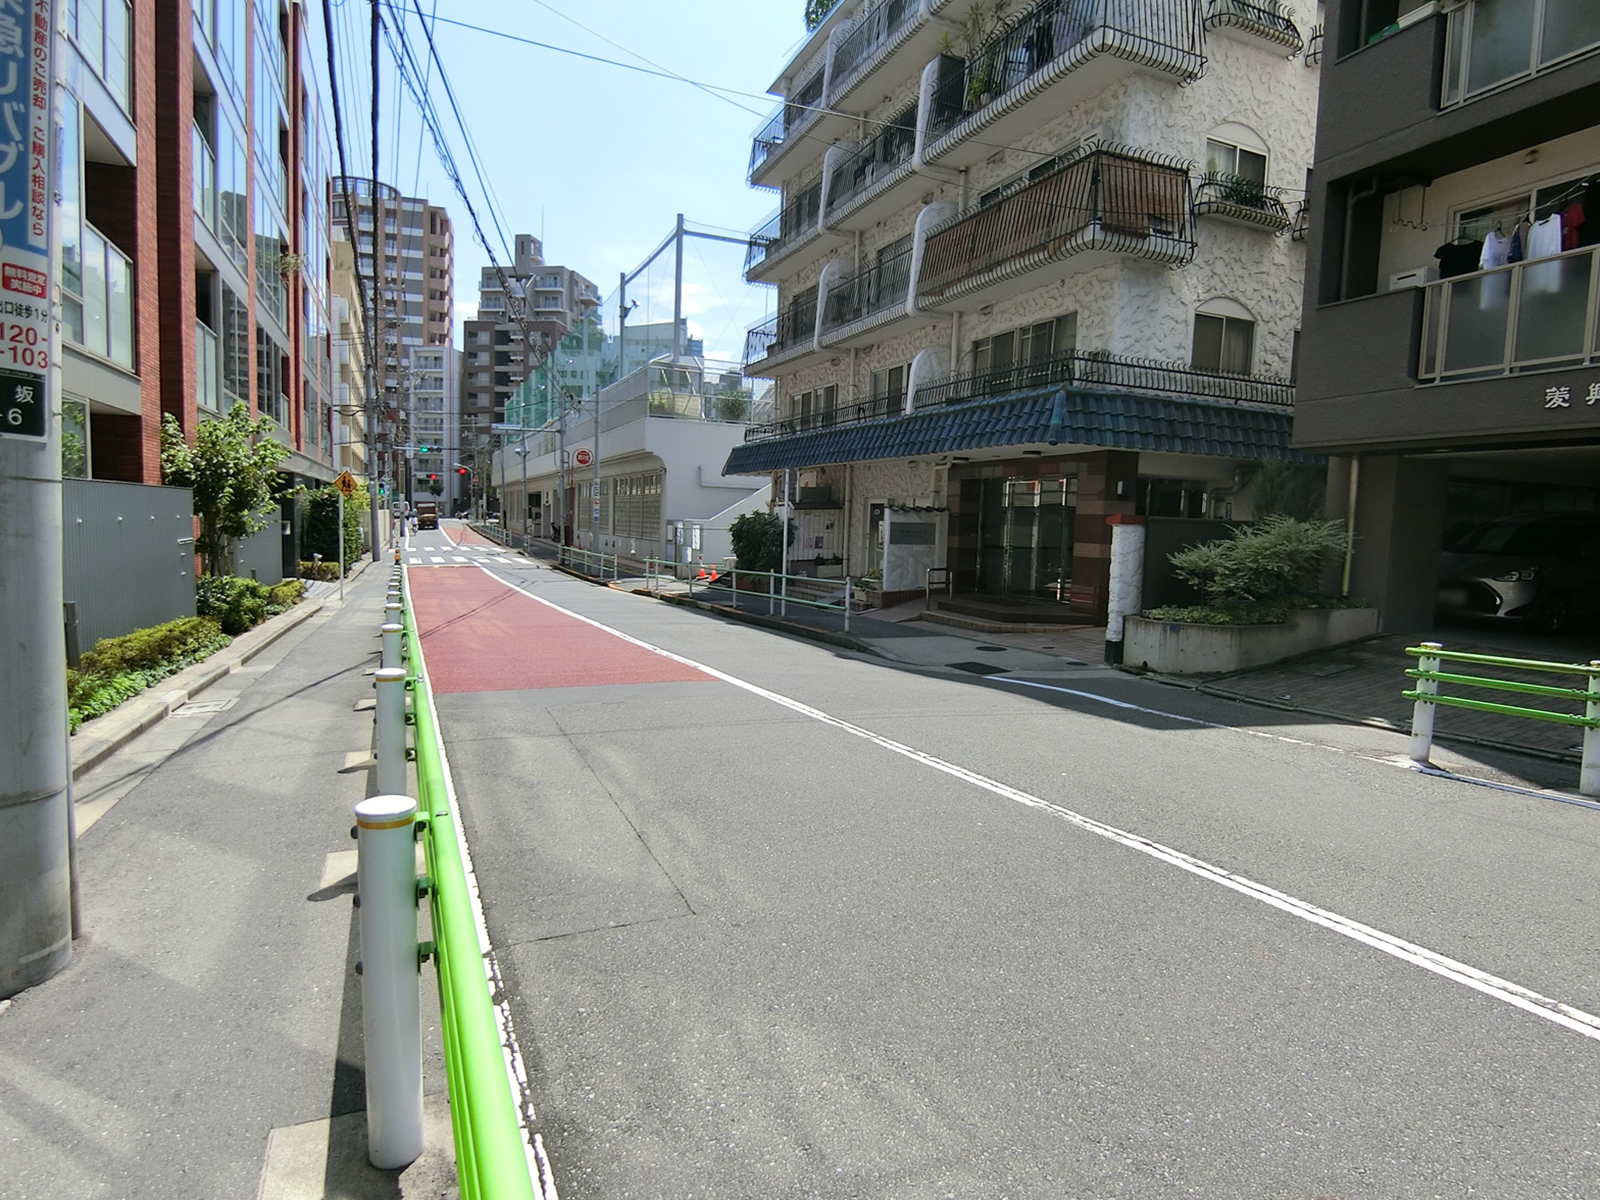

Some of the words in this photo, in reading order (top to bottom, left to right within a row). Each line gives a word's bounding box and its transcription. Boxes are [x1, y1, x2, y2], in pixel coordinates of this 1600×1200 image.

[10, 279, 42, 295] 実施中
[15, 384, 35, 404] 坂
